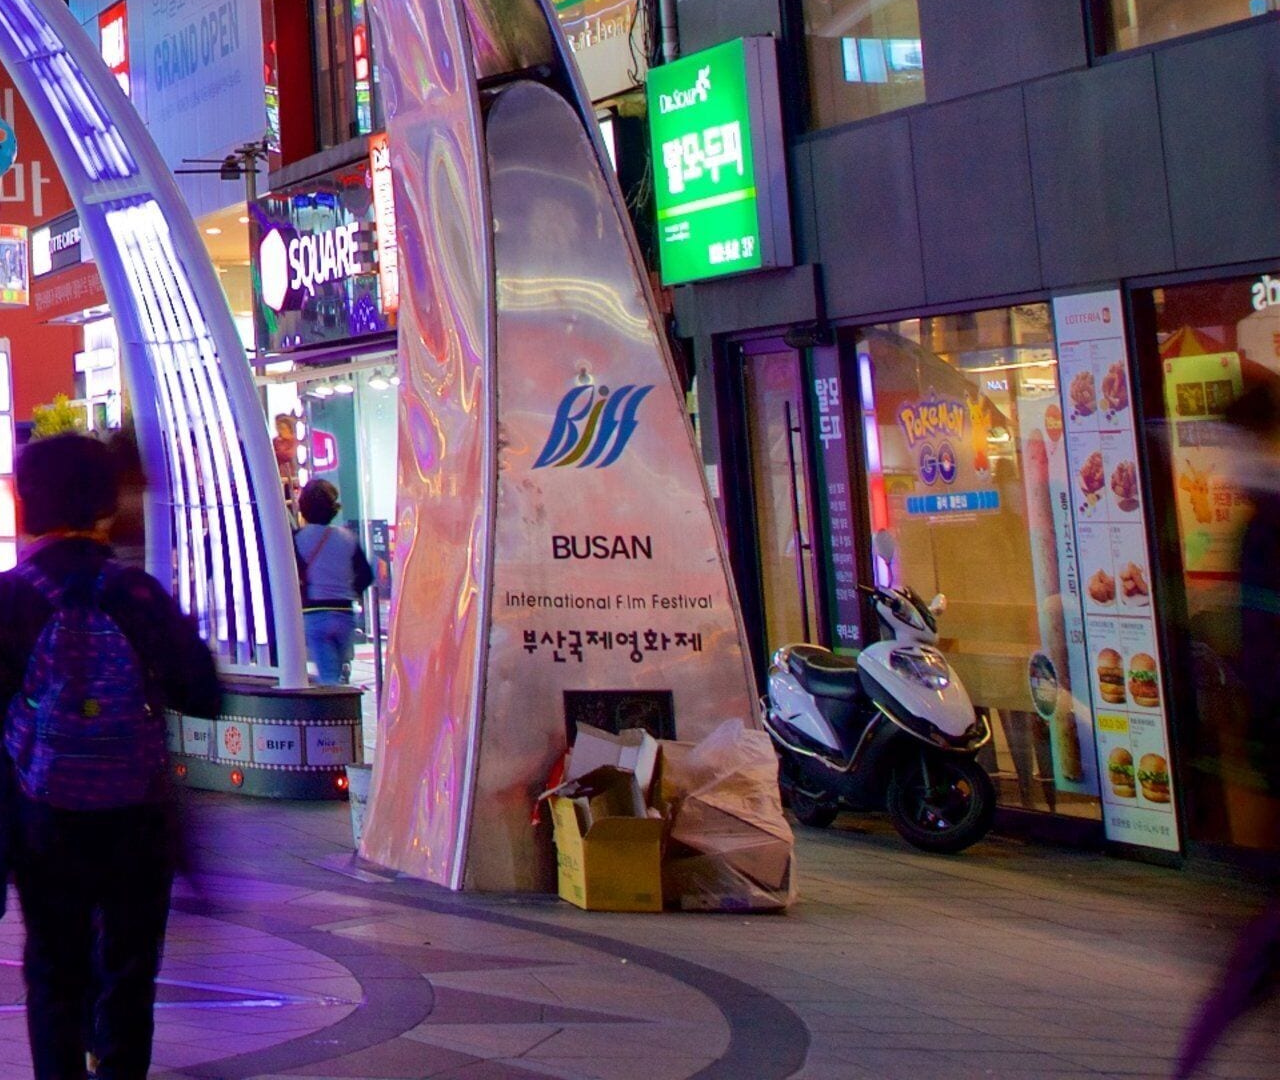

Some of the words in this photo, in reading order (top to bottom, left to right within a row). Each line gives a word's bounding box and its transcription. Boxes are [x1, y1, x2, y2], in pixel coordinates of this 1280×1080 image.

[153, 29, 199, 91] GRAND
[289, 221, 362, 297] SQUARE
[920, 439, 957, 486] GO
[552, 535, 653, 560] BUSAN
[505, 591, 612, 610] International
[615, 594, 646, 610] Flm
[652, 592, 712, 610] Festival
[523, 629, 703, 662] 부산국제영화제
[266, 741, 294, 750] BIFF
